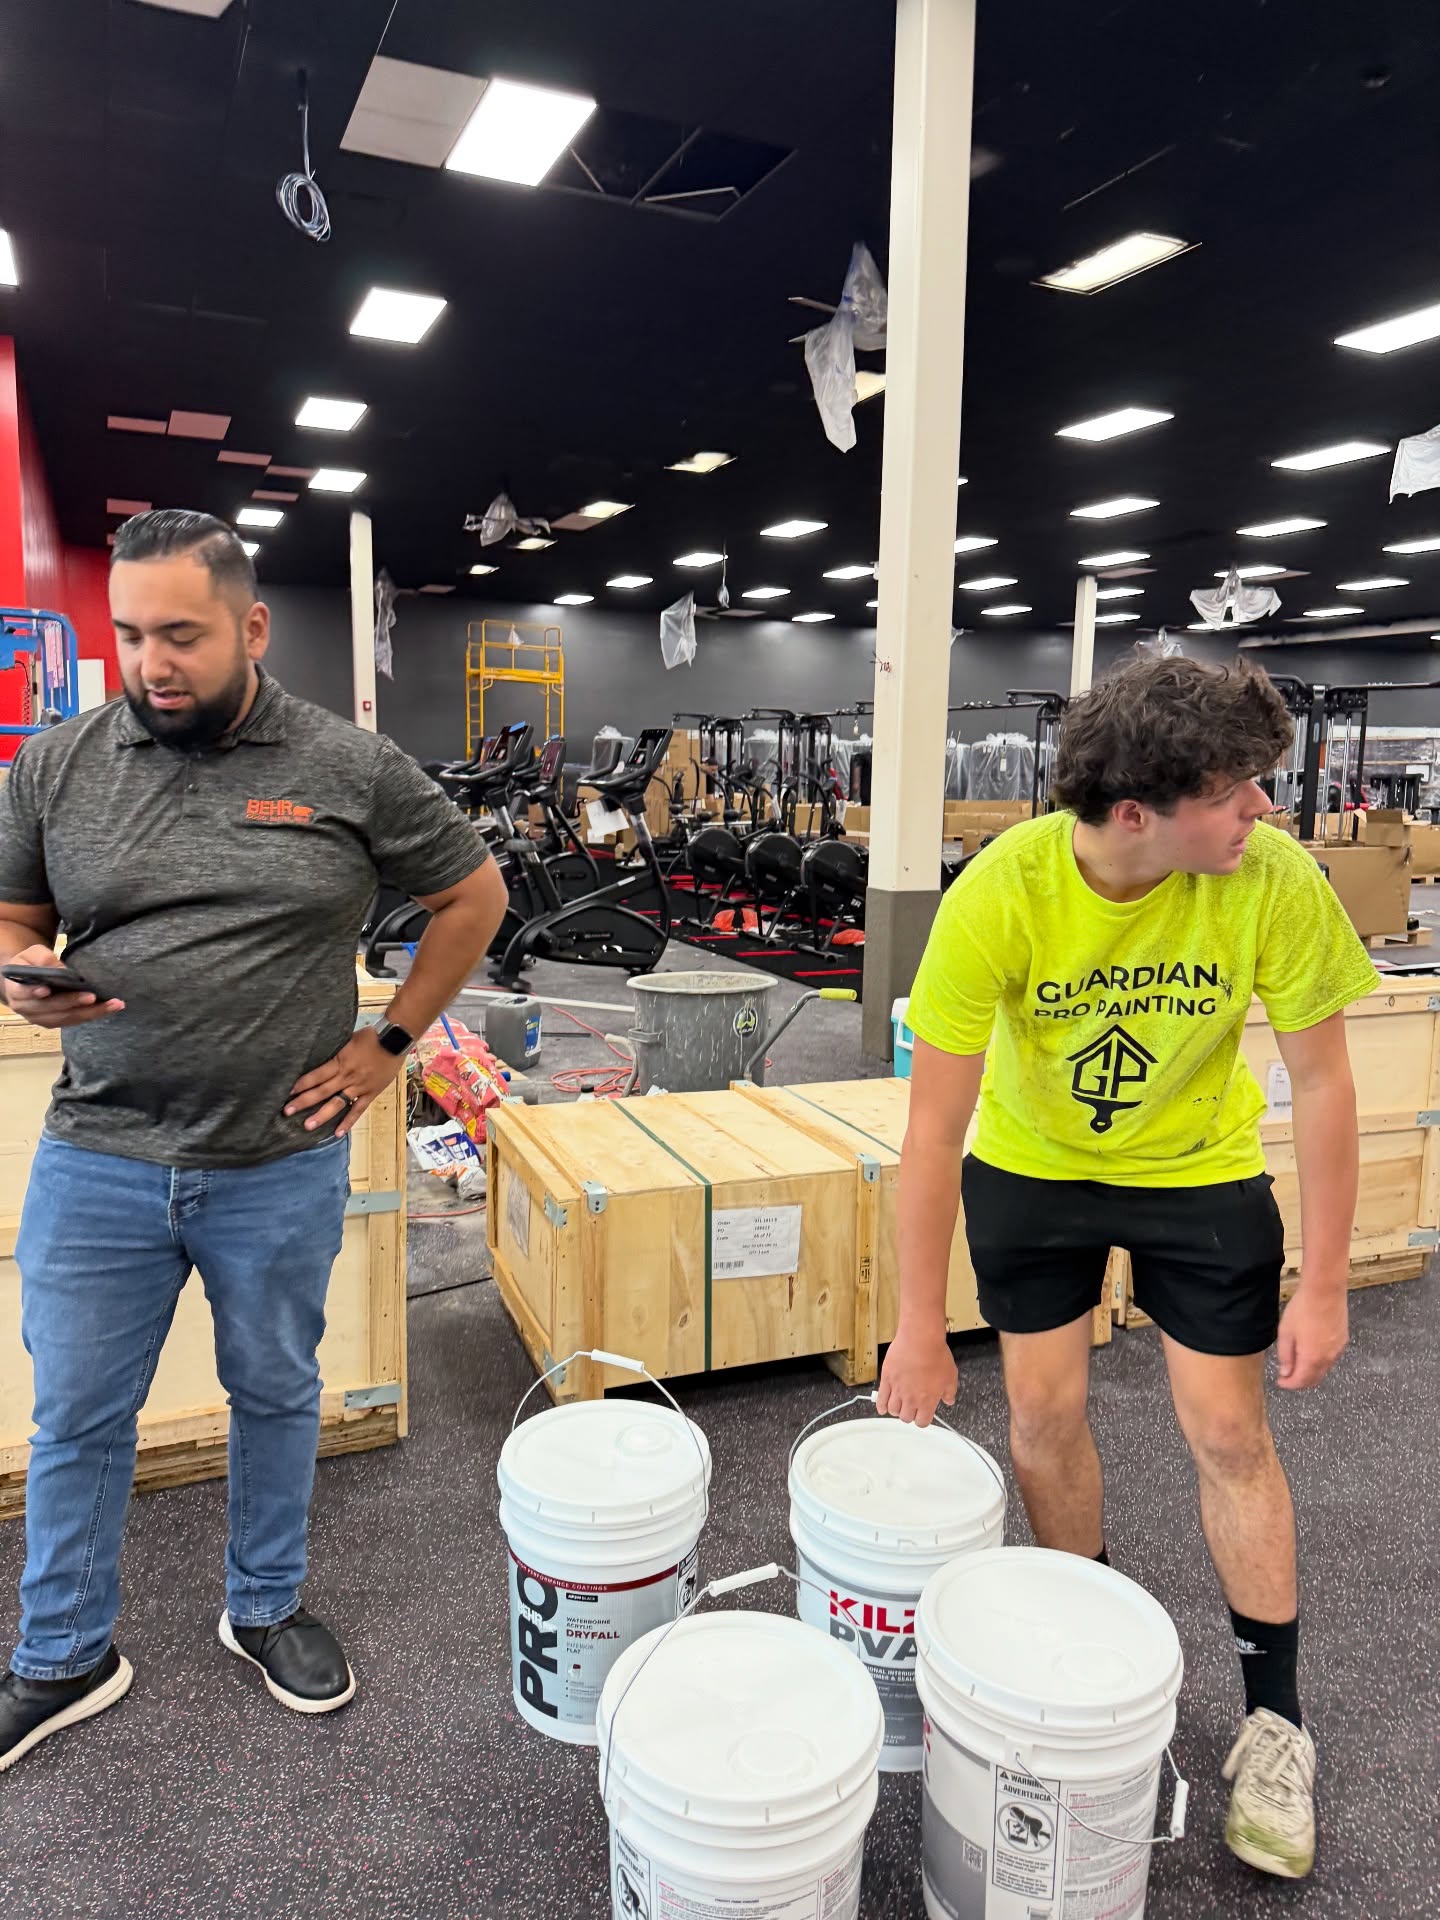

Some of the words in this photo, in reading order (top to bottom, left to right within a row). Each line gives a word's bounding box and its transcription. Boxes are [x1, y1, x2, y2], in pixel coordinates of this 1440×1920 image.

[246, 799, 293, 816] BEHR
[1036, 961, 1218, 1004] GUARDIAN
[1034, 1002, 1091, 1020] PRO
[1096, 995, 1217, 1019] PAINTING
[527, 1568, 570, 1588] PERFORMANCE
[571, 1584, 608, 1592] COATINGS
[517, 1600, 544, 1634] BEHR
[566, 1616, 611, 1625] WATERBORNE
[566, 1622, 593, 1630] ACRYLIC
[516, 1565, 559, 1720] PRO
[566, 1629, 620, 1640] DRYFALL
[1003, 1783, 1052, 1802] ADVERTENCIA
